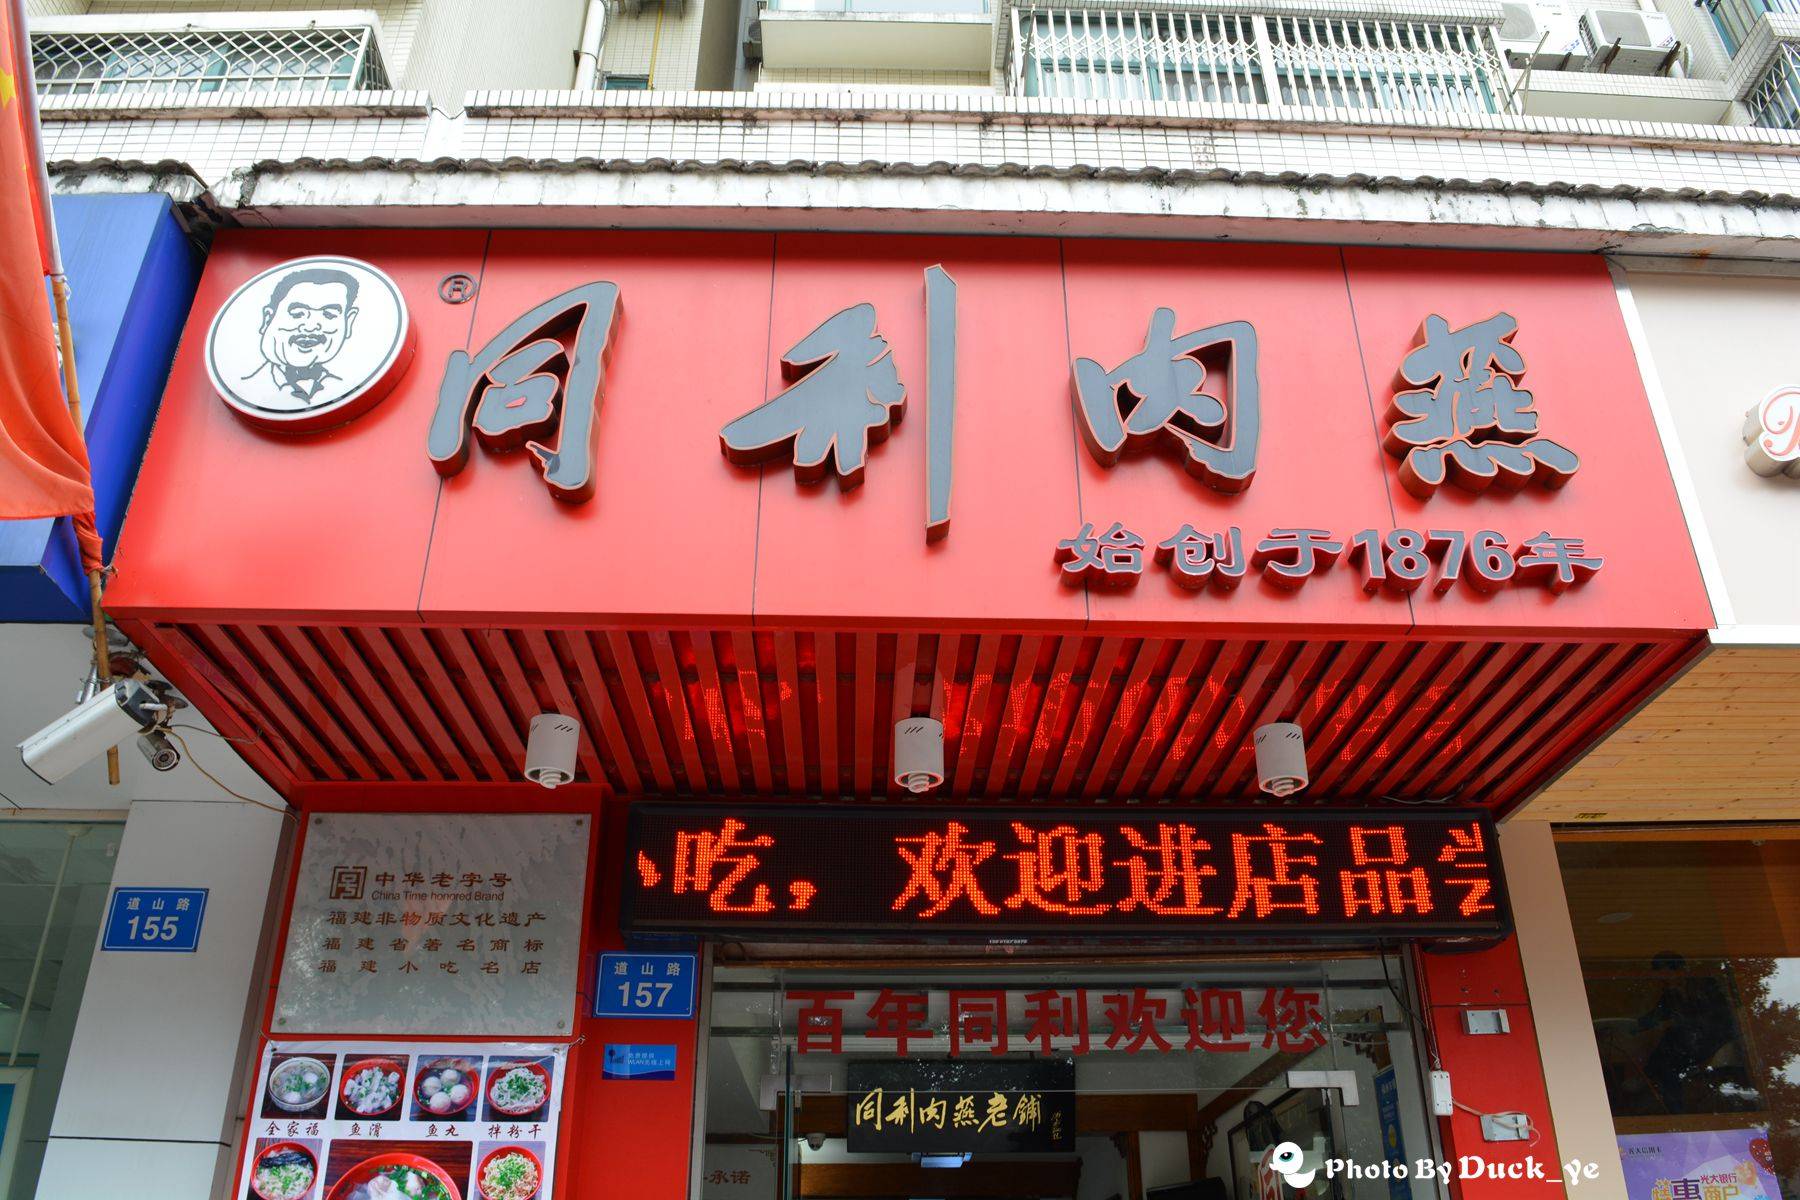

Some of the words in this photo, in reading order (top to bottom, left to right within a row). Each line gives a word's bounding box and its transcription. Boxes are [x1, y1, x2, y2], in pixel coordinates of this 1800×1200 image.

[427, 264, 1580, 545] 同利肉燕
[1056, 520, 1604, 584] 始创于1876年
[638, 817, 1495, 918] 吃，欢迎进店品
[375, 871, 512, 888] 中华老字号
[371, 890, 400, 901] China
[403, 890, 427, 901] Time
[431, 890, 472, 901] honored
[474, 890, 505, 901] Brand
[126, 897, 190, 911] 道山路
[327, 911, 546, 927] 福建非物质文化遗产
[128, 915, 179, 941] 155
[322, 937, 544, 952] 福建省著名商标
[318, 959, 542, 974] 福建小吃名店
[614, 961, 681, 976] 道山路
[618, 981, 673, 1008] 157
[785, 987, 1328, 1057] 百年同利欢迎您
[265, 1121, 319, 1137] 全家福
[425, 1123, 459, 1138] 鱼丸
[488, 1123, 542, 1139] 拌粉干
[1700, 1172, 1737, 1184] 光大银行
